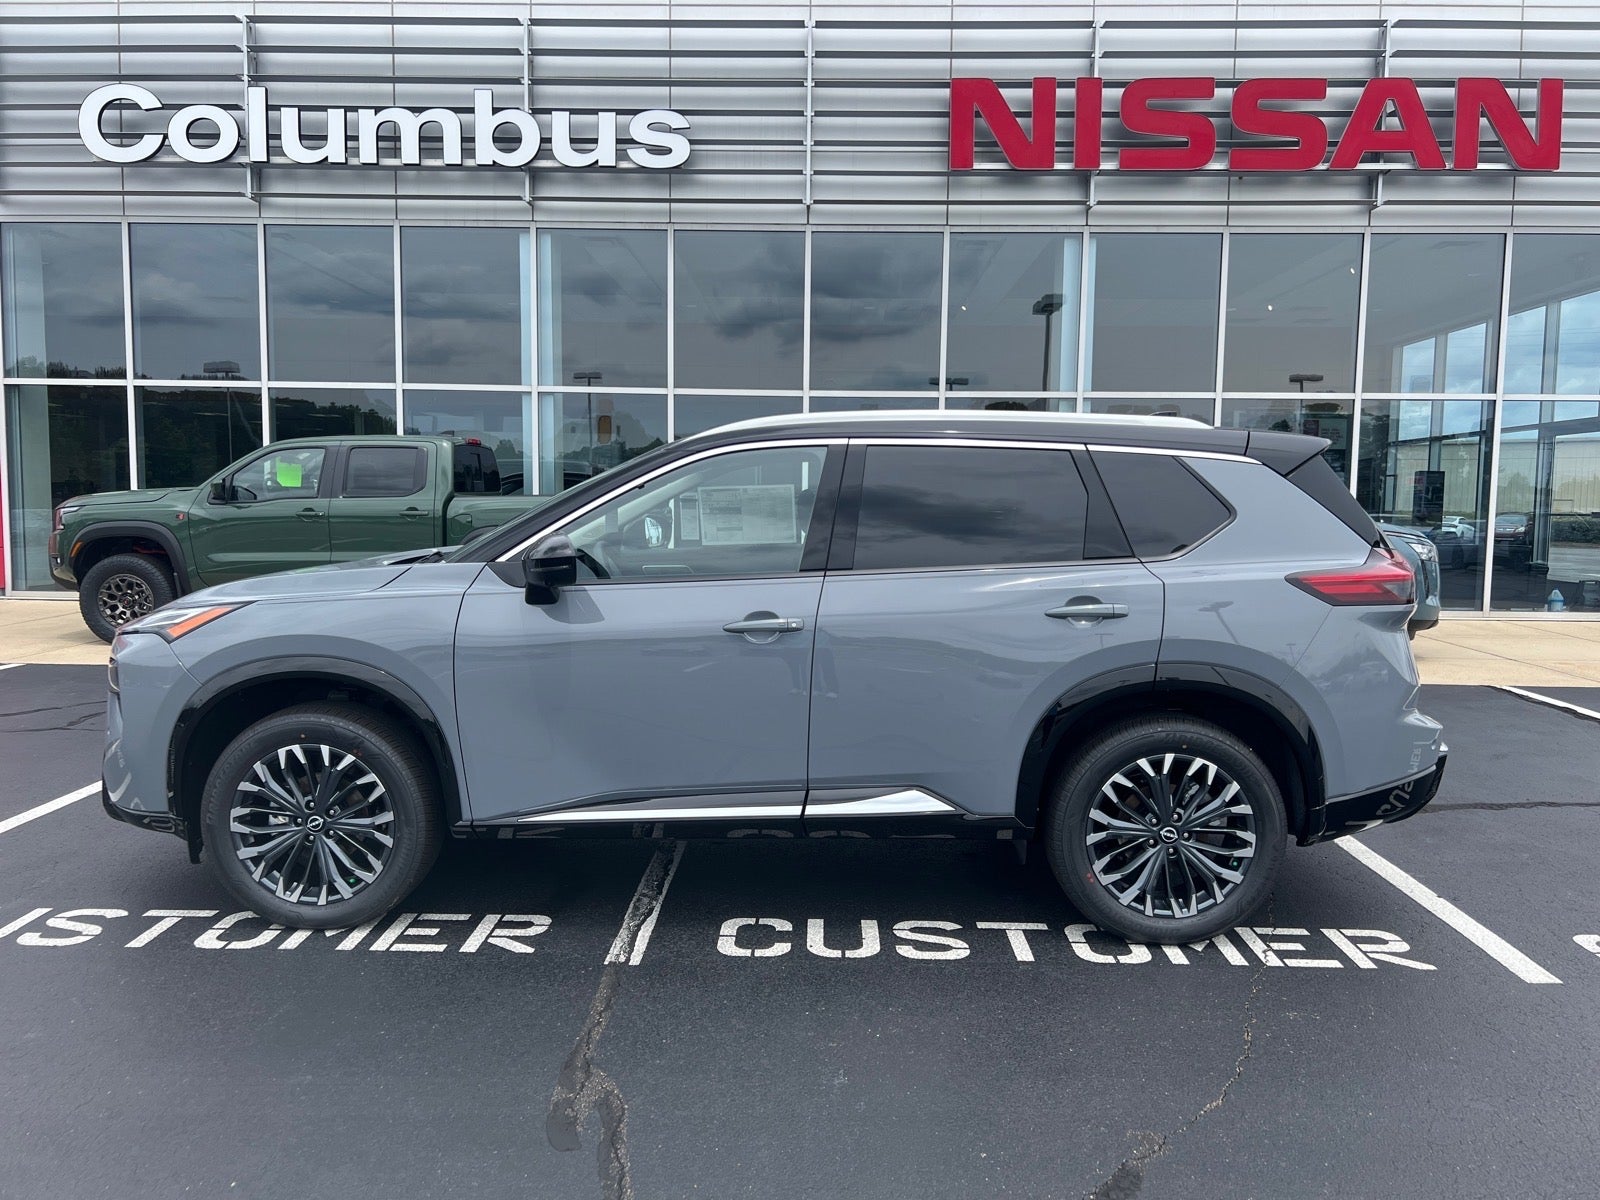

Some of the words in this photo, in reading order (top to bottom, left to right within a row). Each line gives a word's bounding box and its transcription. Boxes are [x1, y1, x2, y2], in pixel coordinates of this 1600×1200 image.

[78, 82, 692, 170] Columbus
[949, 76, 1564, 172] NISSAN
[715, 917, 1438, 971] CUSTOMER
